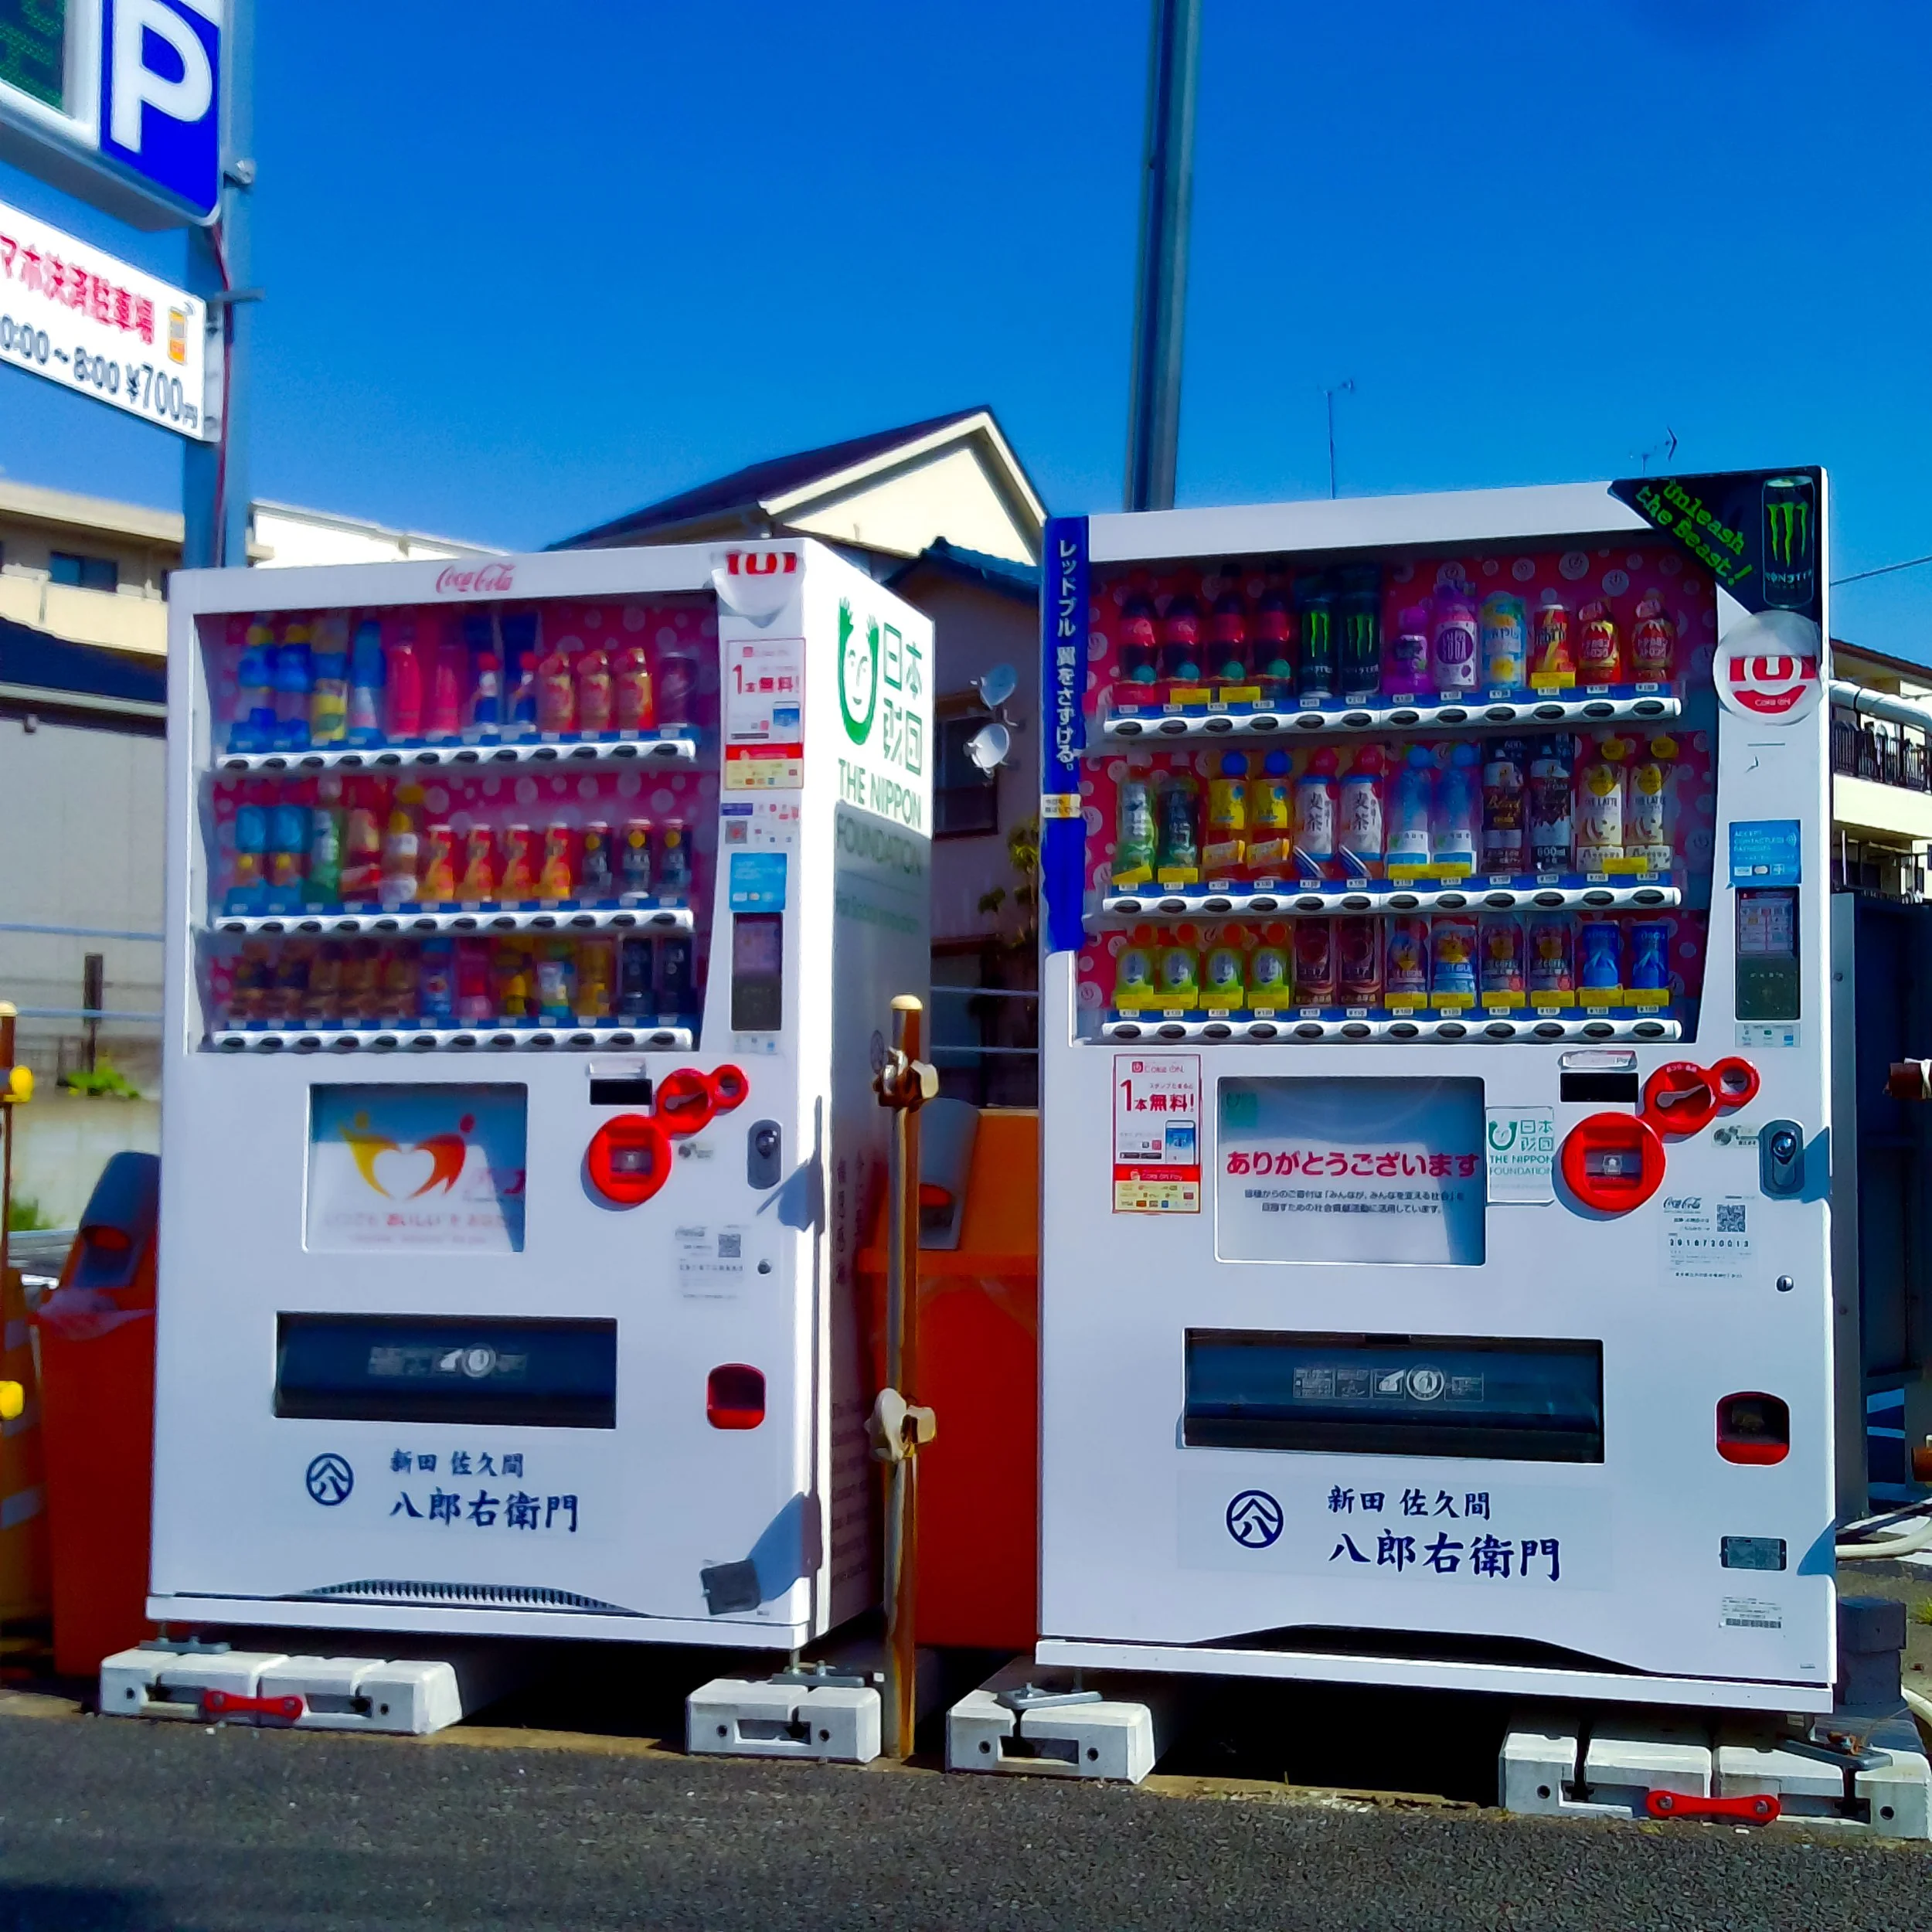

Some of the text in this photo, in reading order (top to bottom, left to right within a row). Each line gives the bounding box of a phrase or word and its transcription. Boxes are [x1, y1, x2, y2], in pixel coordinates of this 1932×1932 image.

[111, 0, 213, 154] P
[838, 757, 922, 830] THE NIPPON
[1120, 1079, 1195, 1113] 1本無料!
[1226, 1150, 1481, 1178] ありがとうございます
[1489, 1155, 1553, 1164] THE NIPPON
[389, 1447, 438, 1475] 新田
[389, 1485, 579, 1533] 八郎右衛門
[1326, 1484, 1492, 1522] 新田 佐久間
[1327, 1527, 1562, 1582] 八郎右衛門
